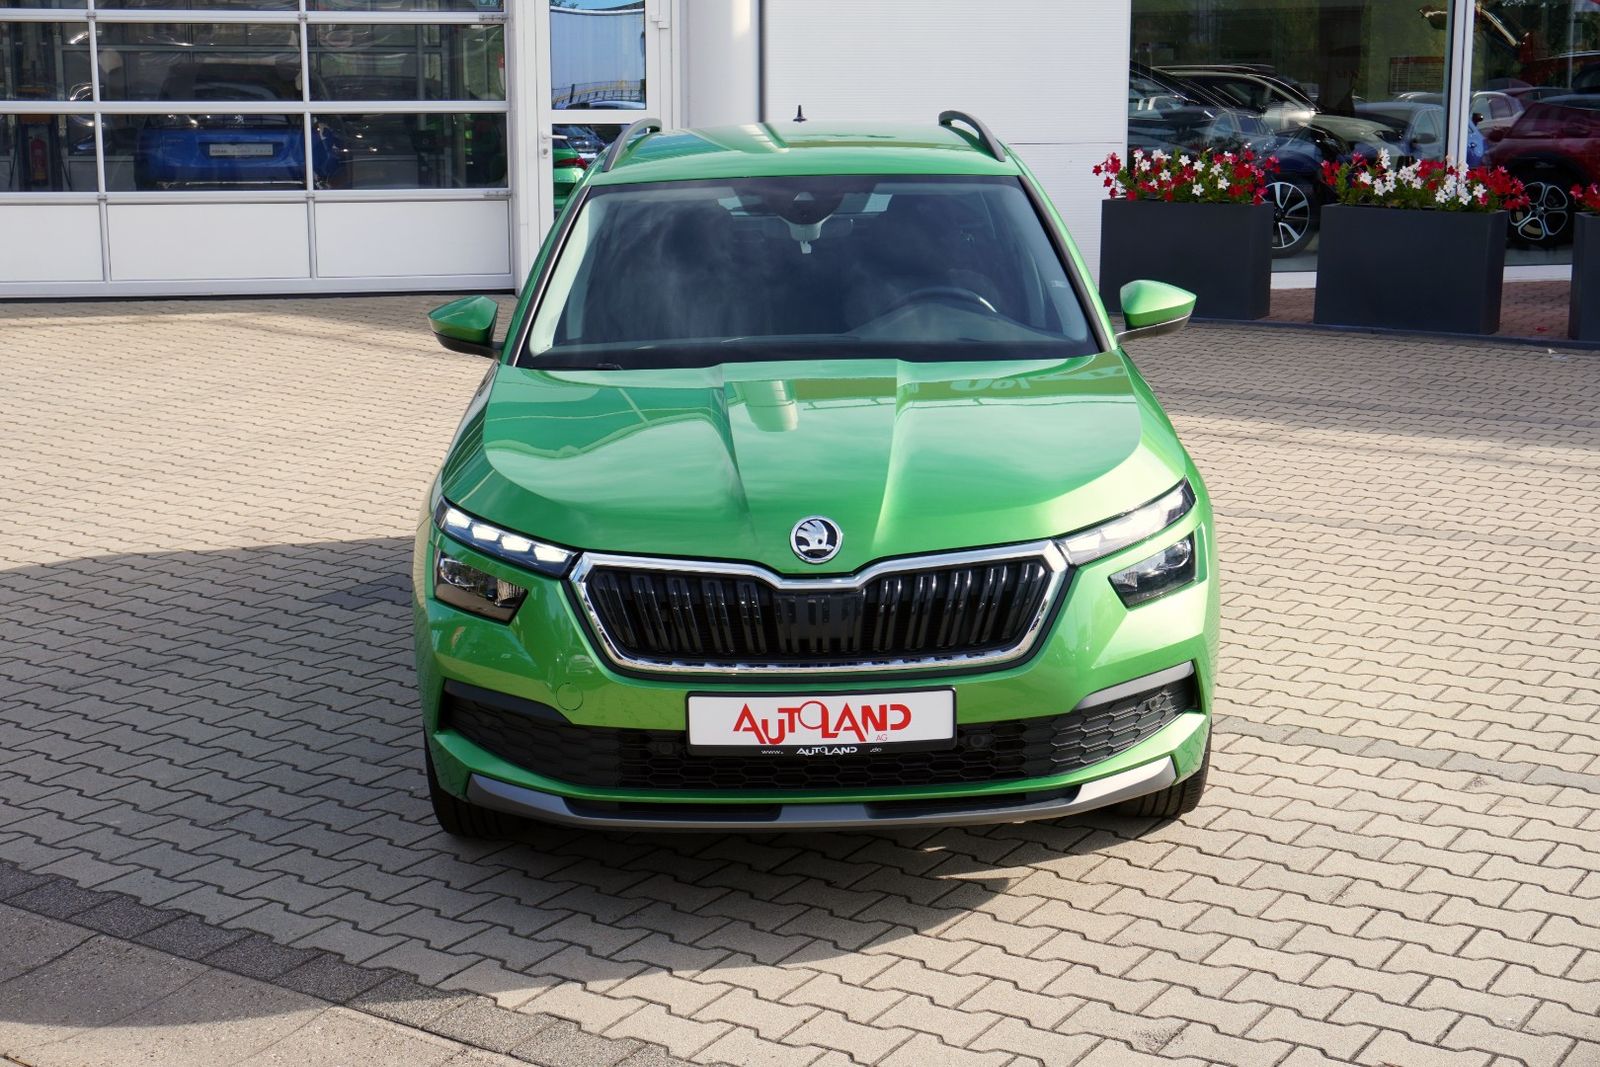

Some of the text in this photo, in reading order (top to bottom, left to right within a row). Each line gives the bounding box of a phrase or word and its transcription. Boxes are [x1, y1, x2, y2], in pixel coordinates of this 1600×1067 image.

[733, 700, 912, 745] AUTOLAND
[875, 733, 888, 743] AG
[796, 746, 858, 756] AUTOLAND
